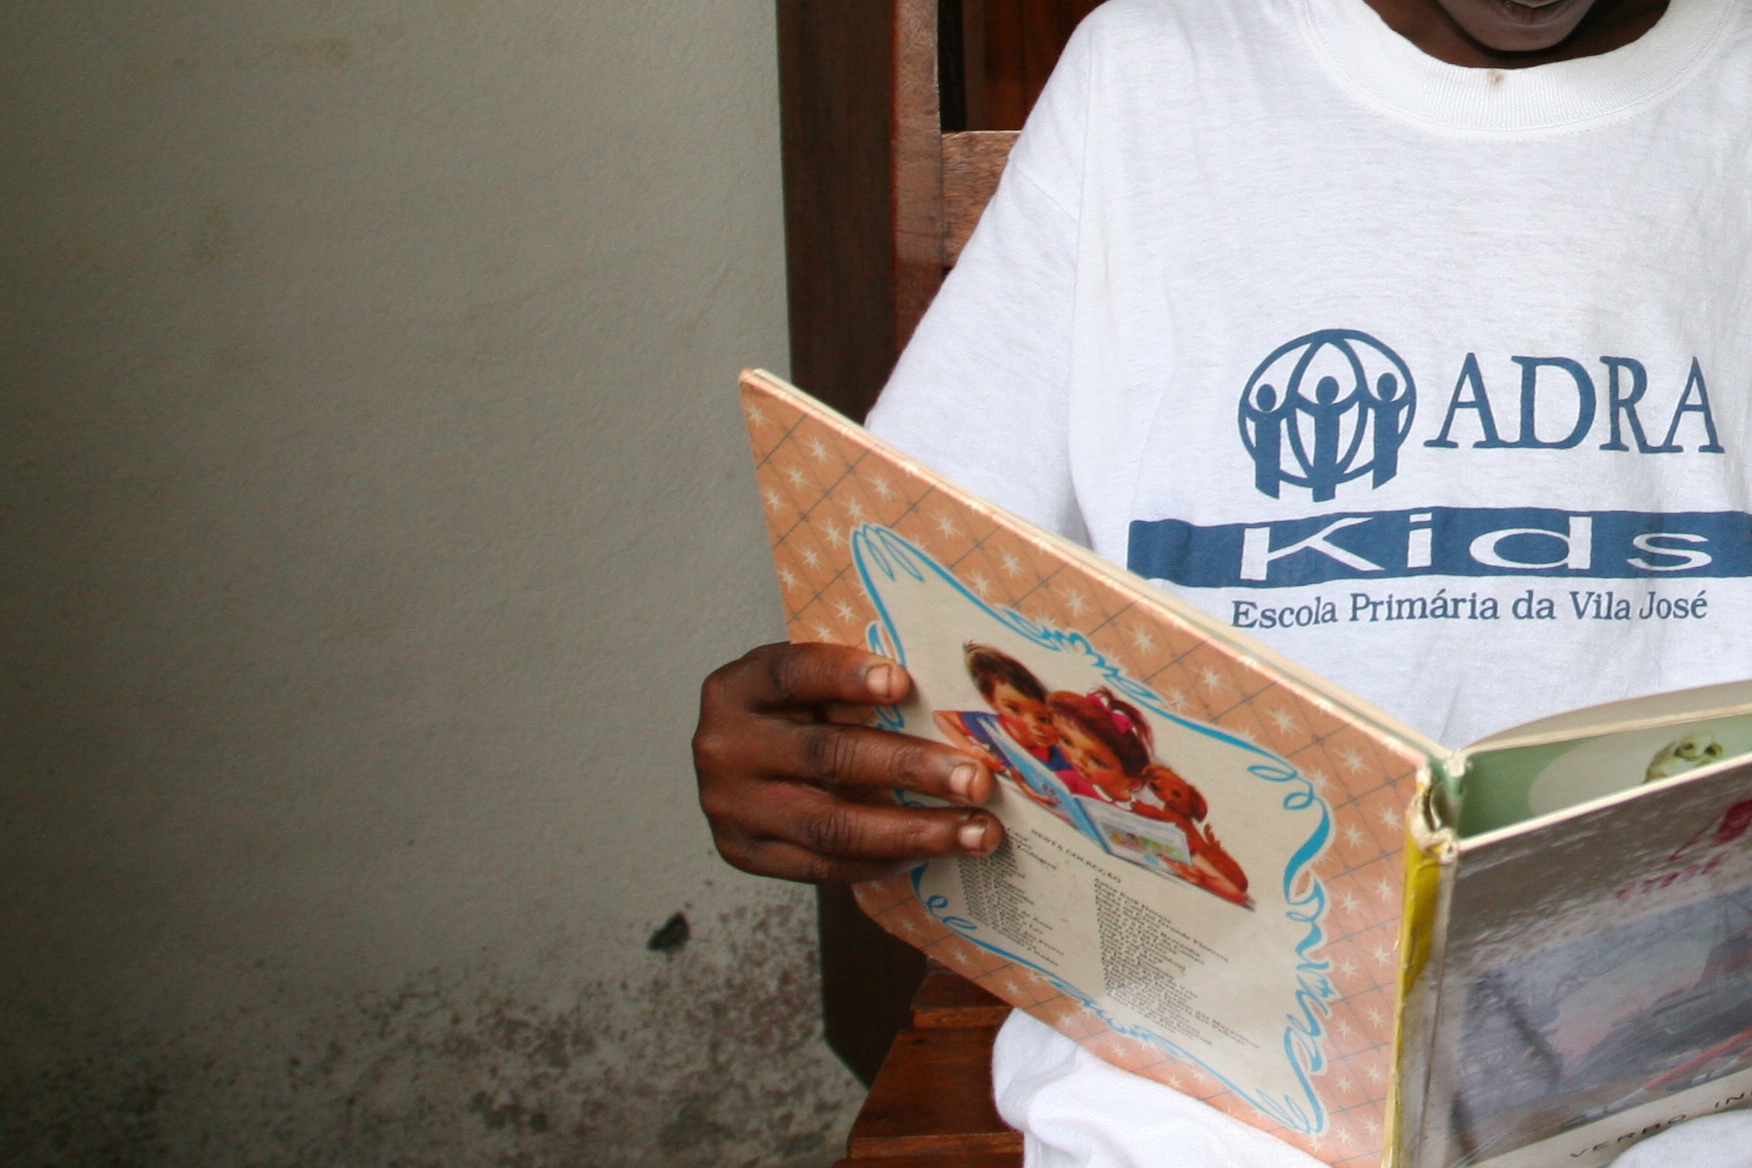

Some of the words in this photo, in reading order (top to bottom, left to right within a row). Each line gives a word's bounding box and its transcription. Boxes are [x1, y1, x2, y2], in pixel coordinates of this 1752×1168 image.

[1424, 352, 1725, 454] ADRA
[1240, 512, 1714, 582] Kids
[1232, 597, 1337, 630] Escola
[1350, 588, 1500, 622] Primária
[1511, 589, 1555, 621] da
[1570, 591, 1631, 622] Vila
[1638, 589, 1708, 621] José
